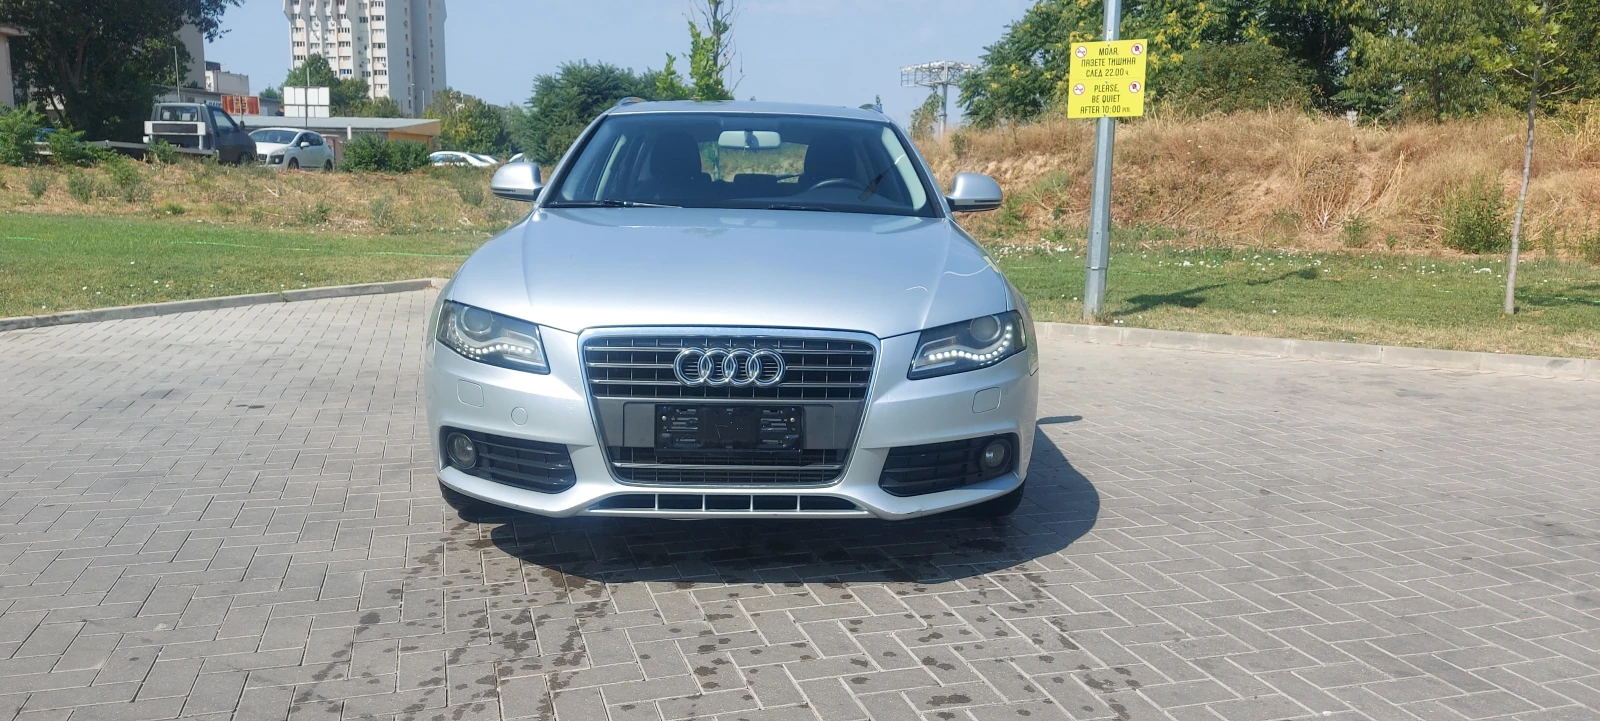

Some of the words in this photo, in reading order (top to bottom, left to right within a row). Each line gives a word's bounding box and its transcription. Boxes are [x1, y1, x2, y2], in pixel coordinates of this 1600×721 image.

[1081, 58, 1105, 67] ПАЗЕТЕ
[1108, 57, 1136, 66] ТИШИНА
[1105, 68, 1124, 76] 22.00
[1094, 84, 1119, 92] PLEASE,
[1102, 95, 1120, 103] QUIET
[1102, 105, 1121, 113] 10:00
